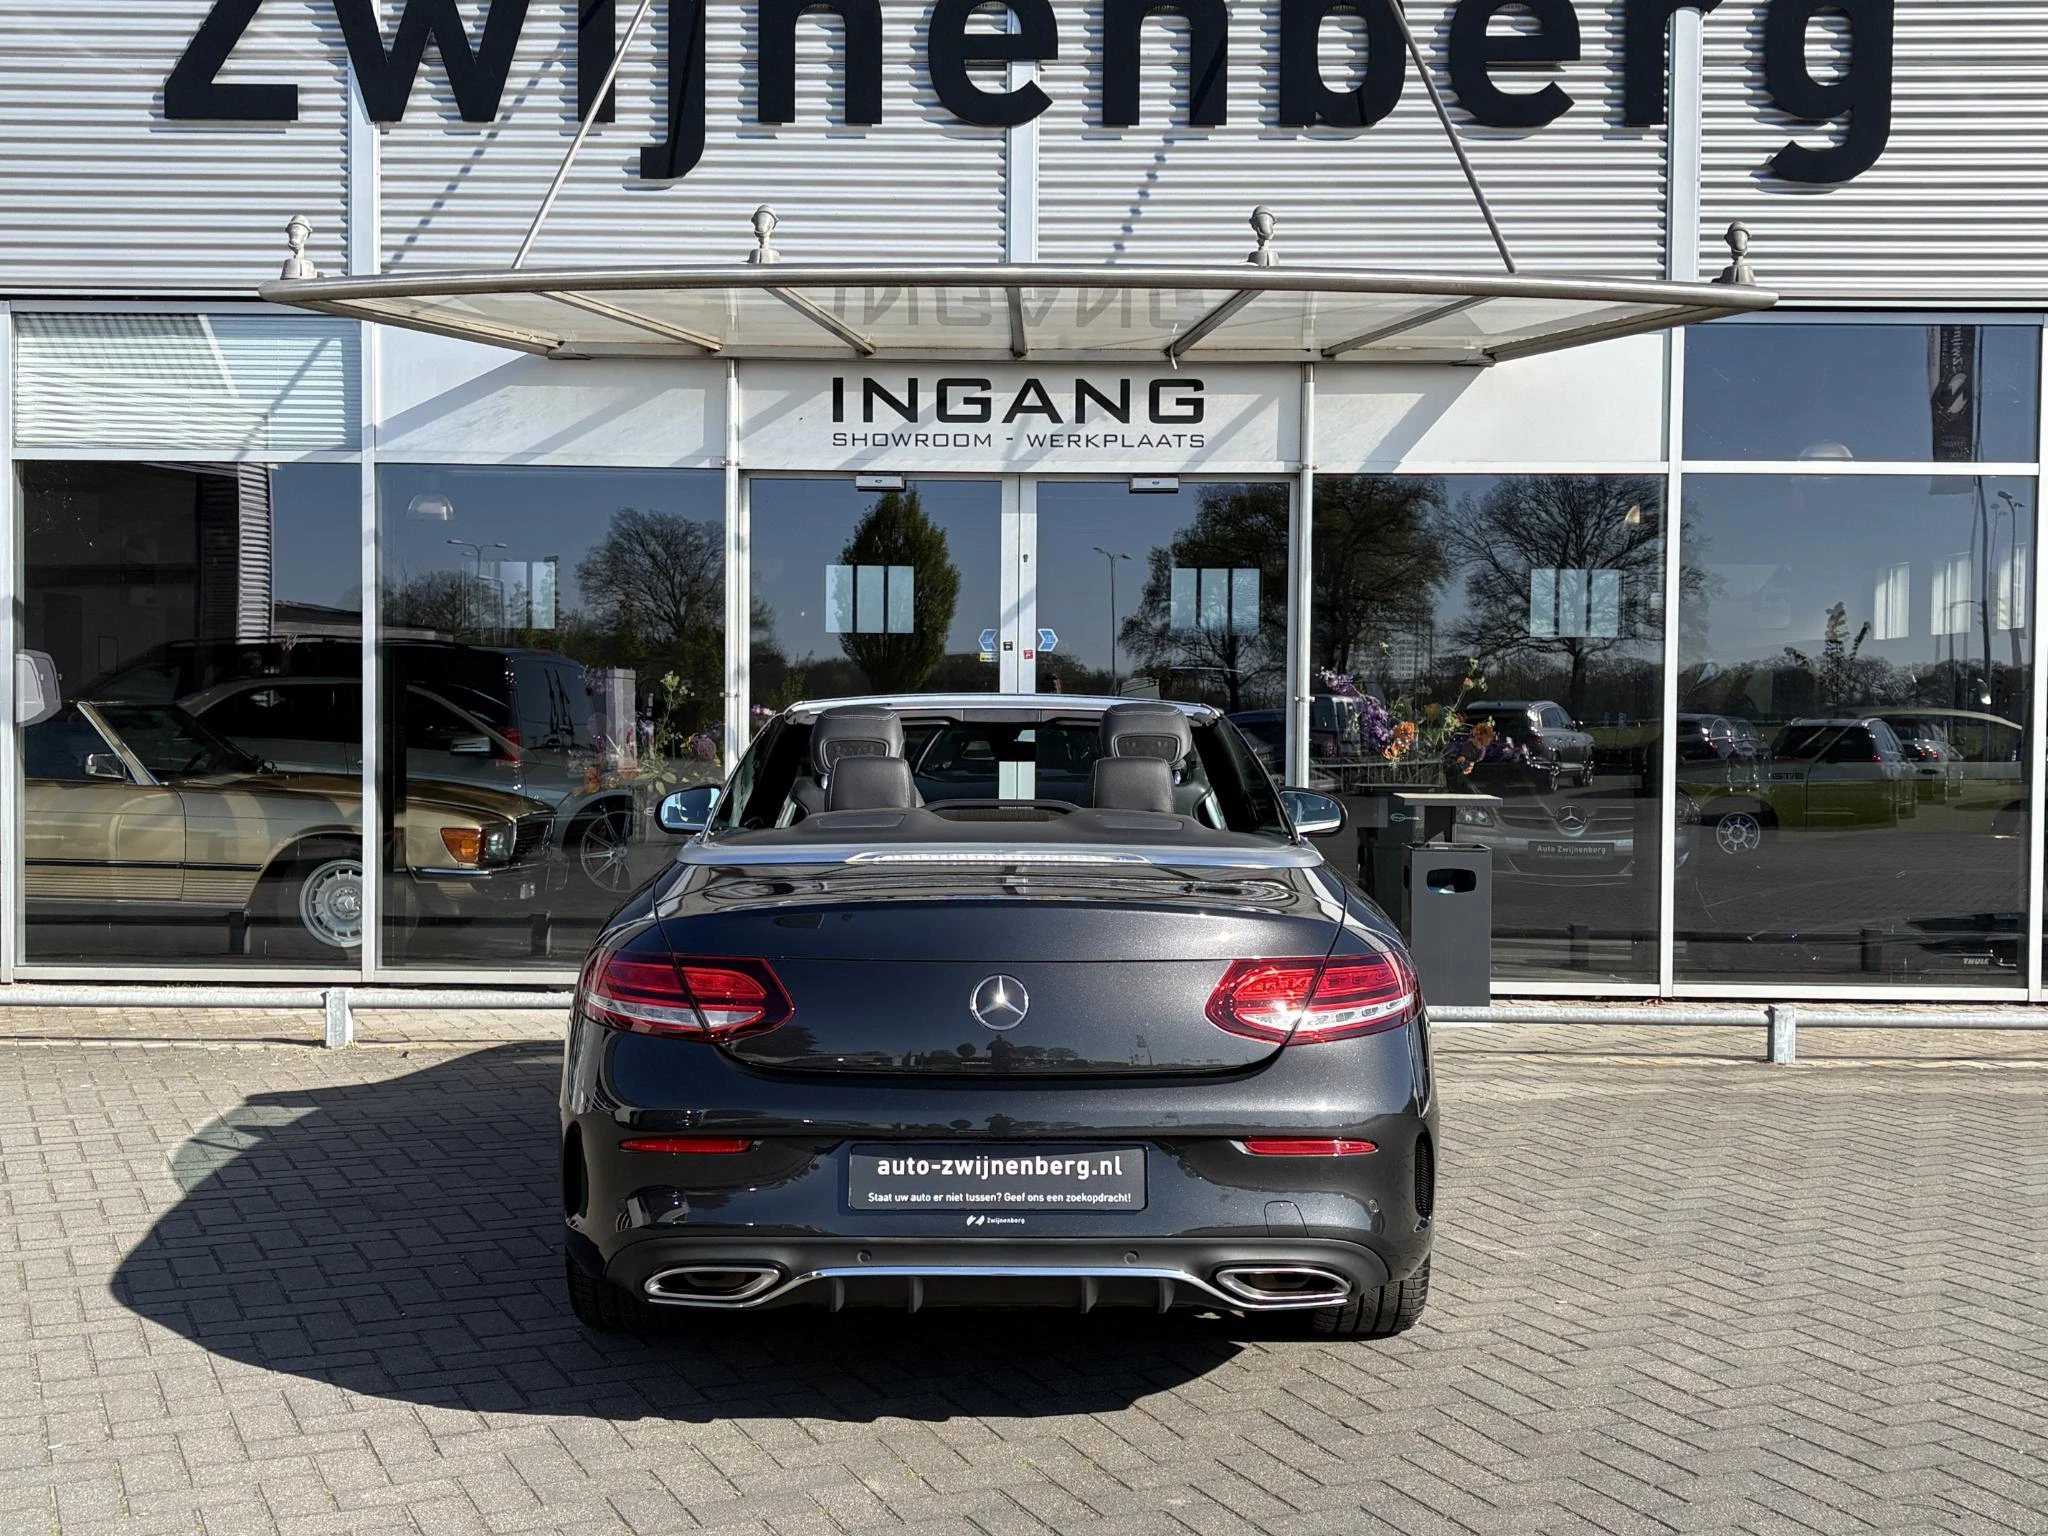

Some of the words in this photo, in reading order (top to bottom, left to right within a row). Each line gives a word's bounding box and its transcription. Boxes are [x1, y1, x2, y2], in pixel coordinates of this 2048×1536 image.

[164, 0, 1893, 184] Zwijnenberg
[832, 376, 1206, 425] INGANG
[832, 432, 992, 448] SHOWROOM
[1027, 433, 1206, 448] WERKPLAATS
[1537, 845, 1555, 853] Auto
[877, 1155, 1123, 1180] auto-zwijnenberg.nl
[868, 1192, 893, 1202] Staat
[894, 1194, 909, 1202] uw
[910, 1193, 932, 1202] auto
[933, 1194, 943, 1202] er
[945, 1192, 964, 1202] niet
[965, 1192, 1002, 1202] tussen?
[1004, 1192, 1026, 1202] Geef
[1027, 1194, 1045, 1202] ons
[1046, 1194, 1064, 1202] een
[1065, 1192, 1132, 1204] zoekopdracht!
